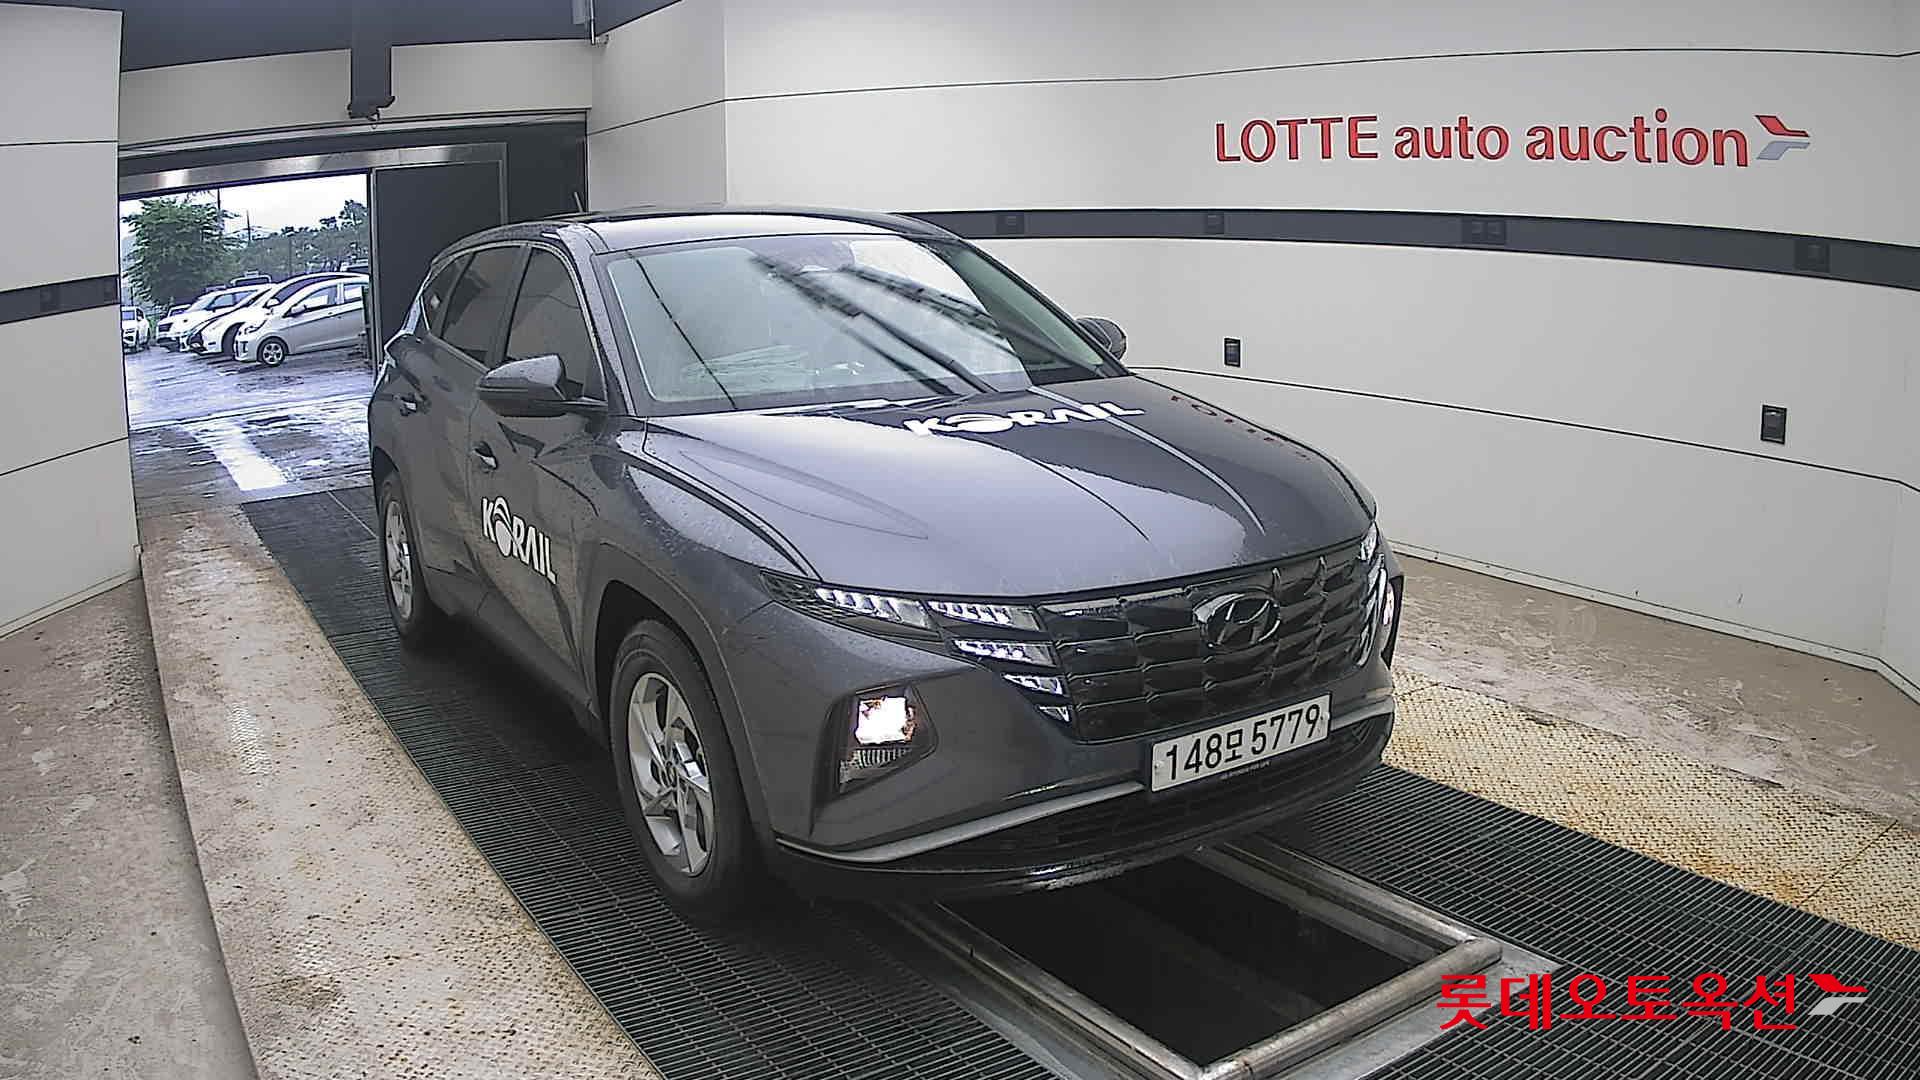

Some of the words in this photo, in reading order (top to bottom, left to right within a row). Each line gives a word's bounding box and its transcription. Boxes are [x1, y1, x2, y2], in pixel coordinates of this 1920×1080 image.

[1216, 115, 1378, 162] LOTTE
[1395, 116, 1510, 160] auto
[1526, 109, 1749, 167] auction
[903, 401, 1145, 437] KORAIL
[482, 497, 557, 585] KORAIL
[1166, 728, 1243, 780] 148모
[1251, 704, 1320, 756] 5779
